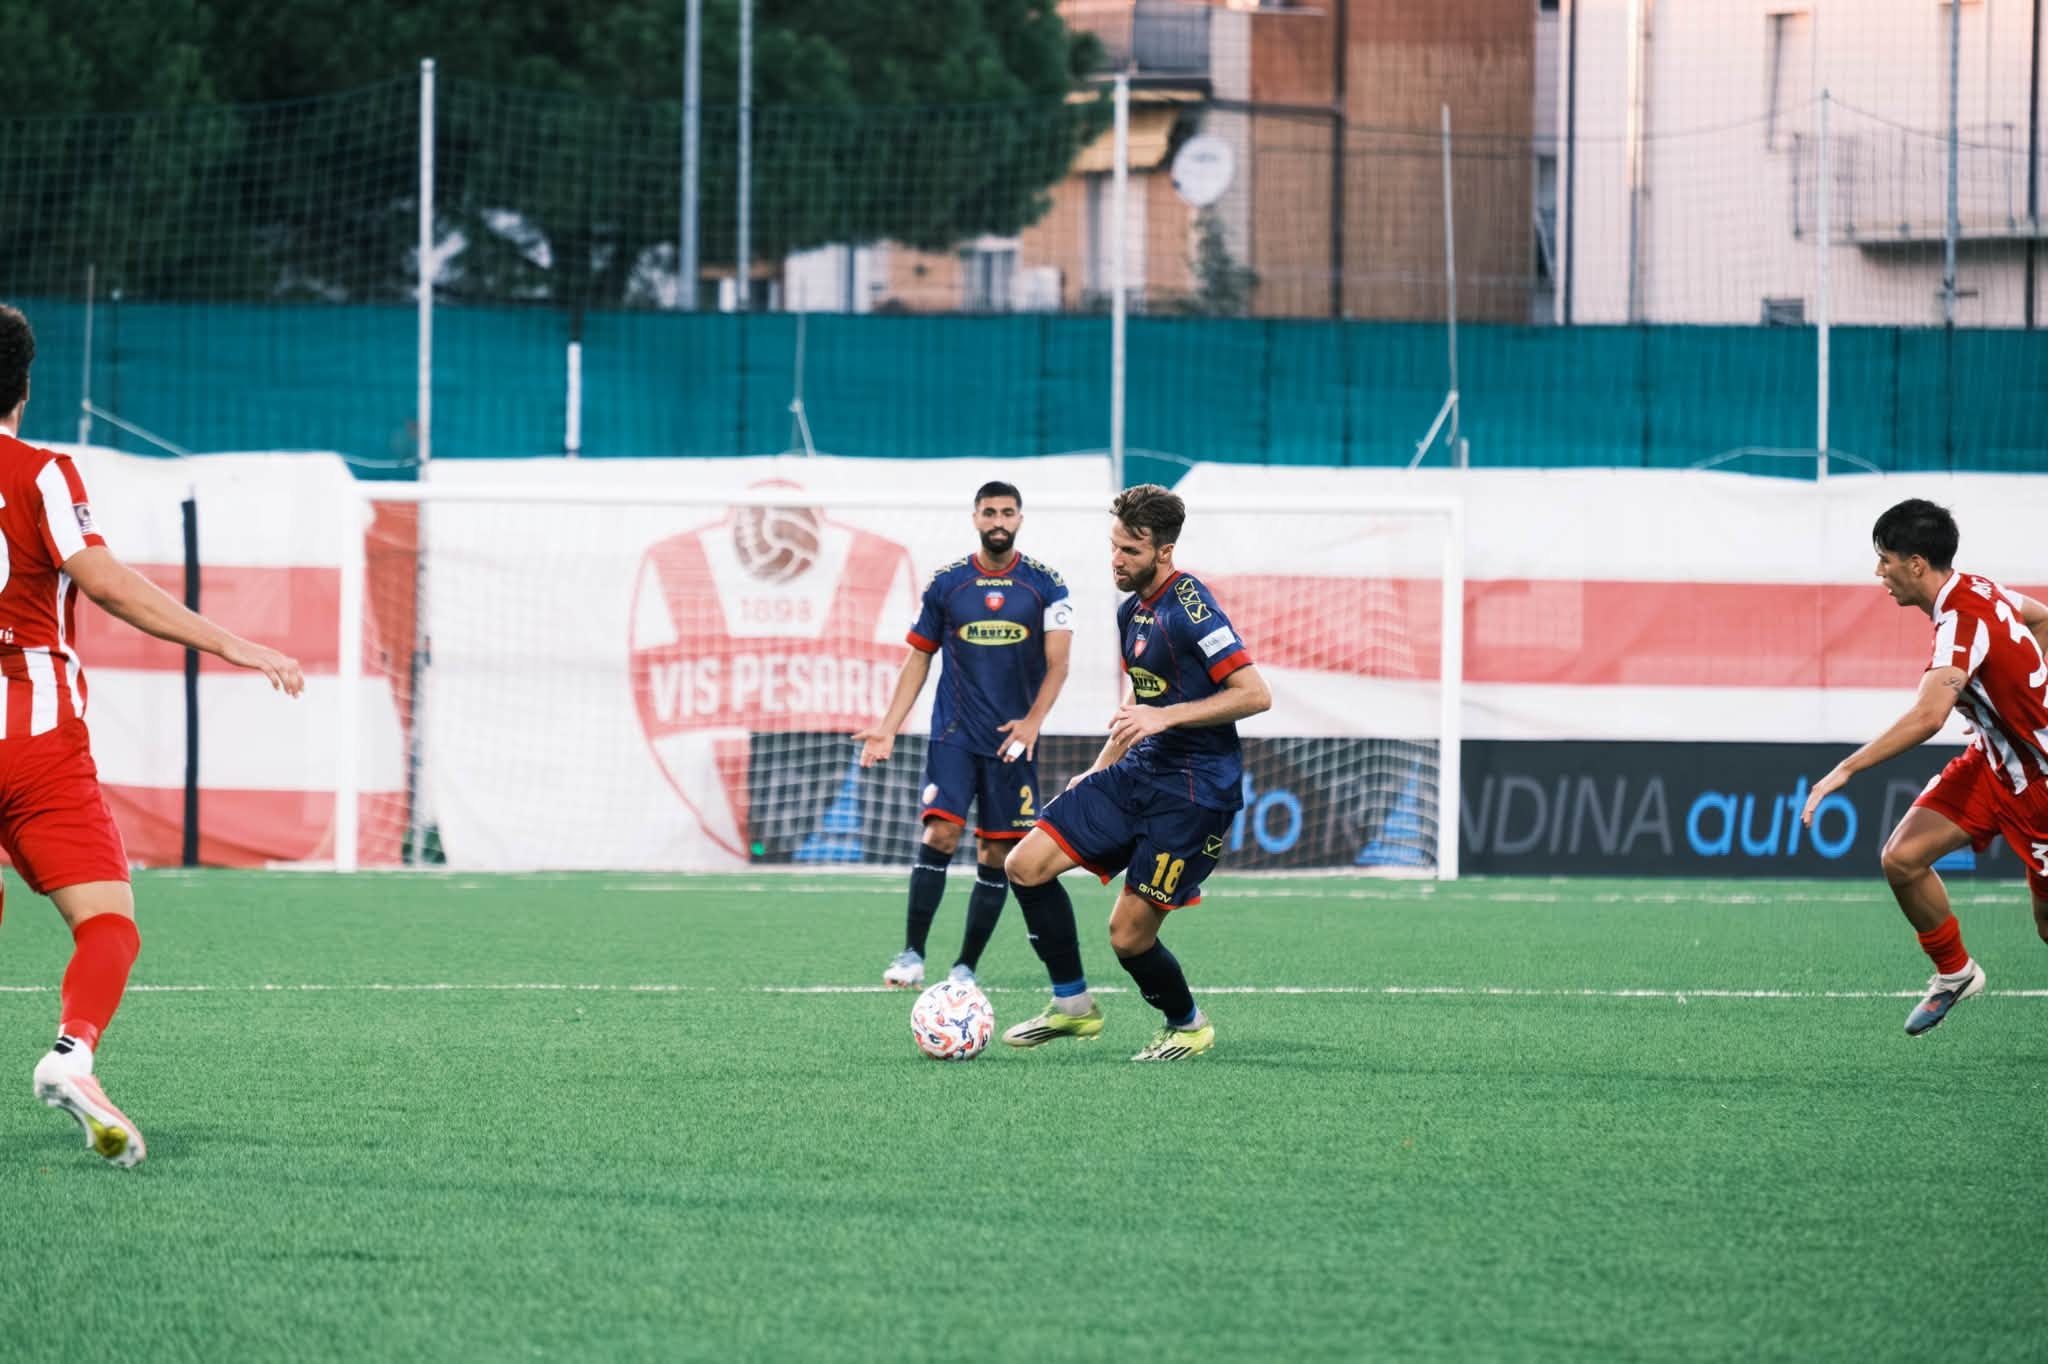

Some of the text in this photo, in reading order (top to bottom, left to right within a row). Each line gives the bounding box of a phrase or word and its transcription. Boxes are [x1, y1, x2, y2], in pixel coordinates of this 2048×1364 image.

[1055, 611, 1067, 624] C
[650, 660, 721, 722] VIS
[1020, 784, 1035, 815] 2
[1686, 776, 1858, 858] auto
[1151, 852, 1185, 894] 18
[1138, 882, 1172, 903] GIVOV
